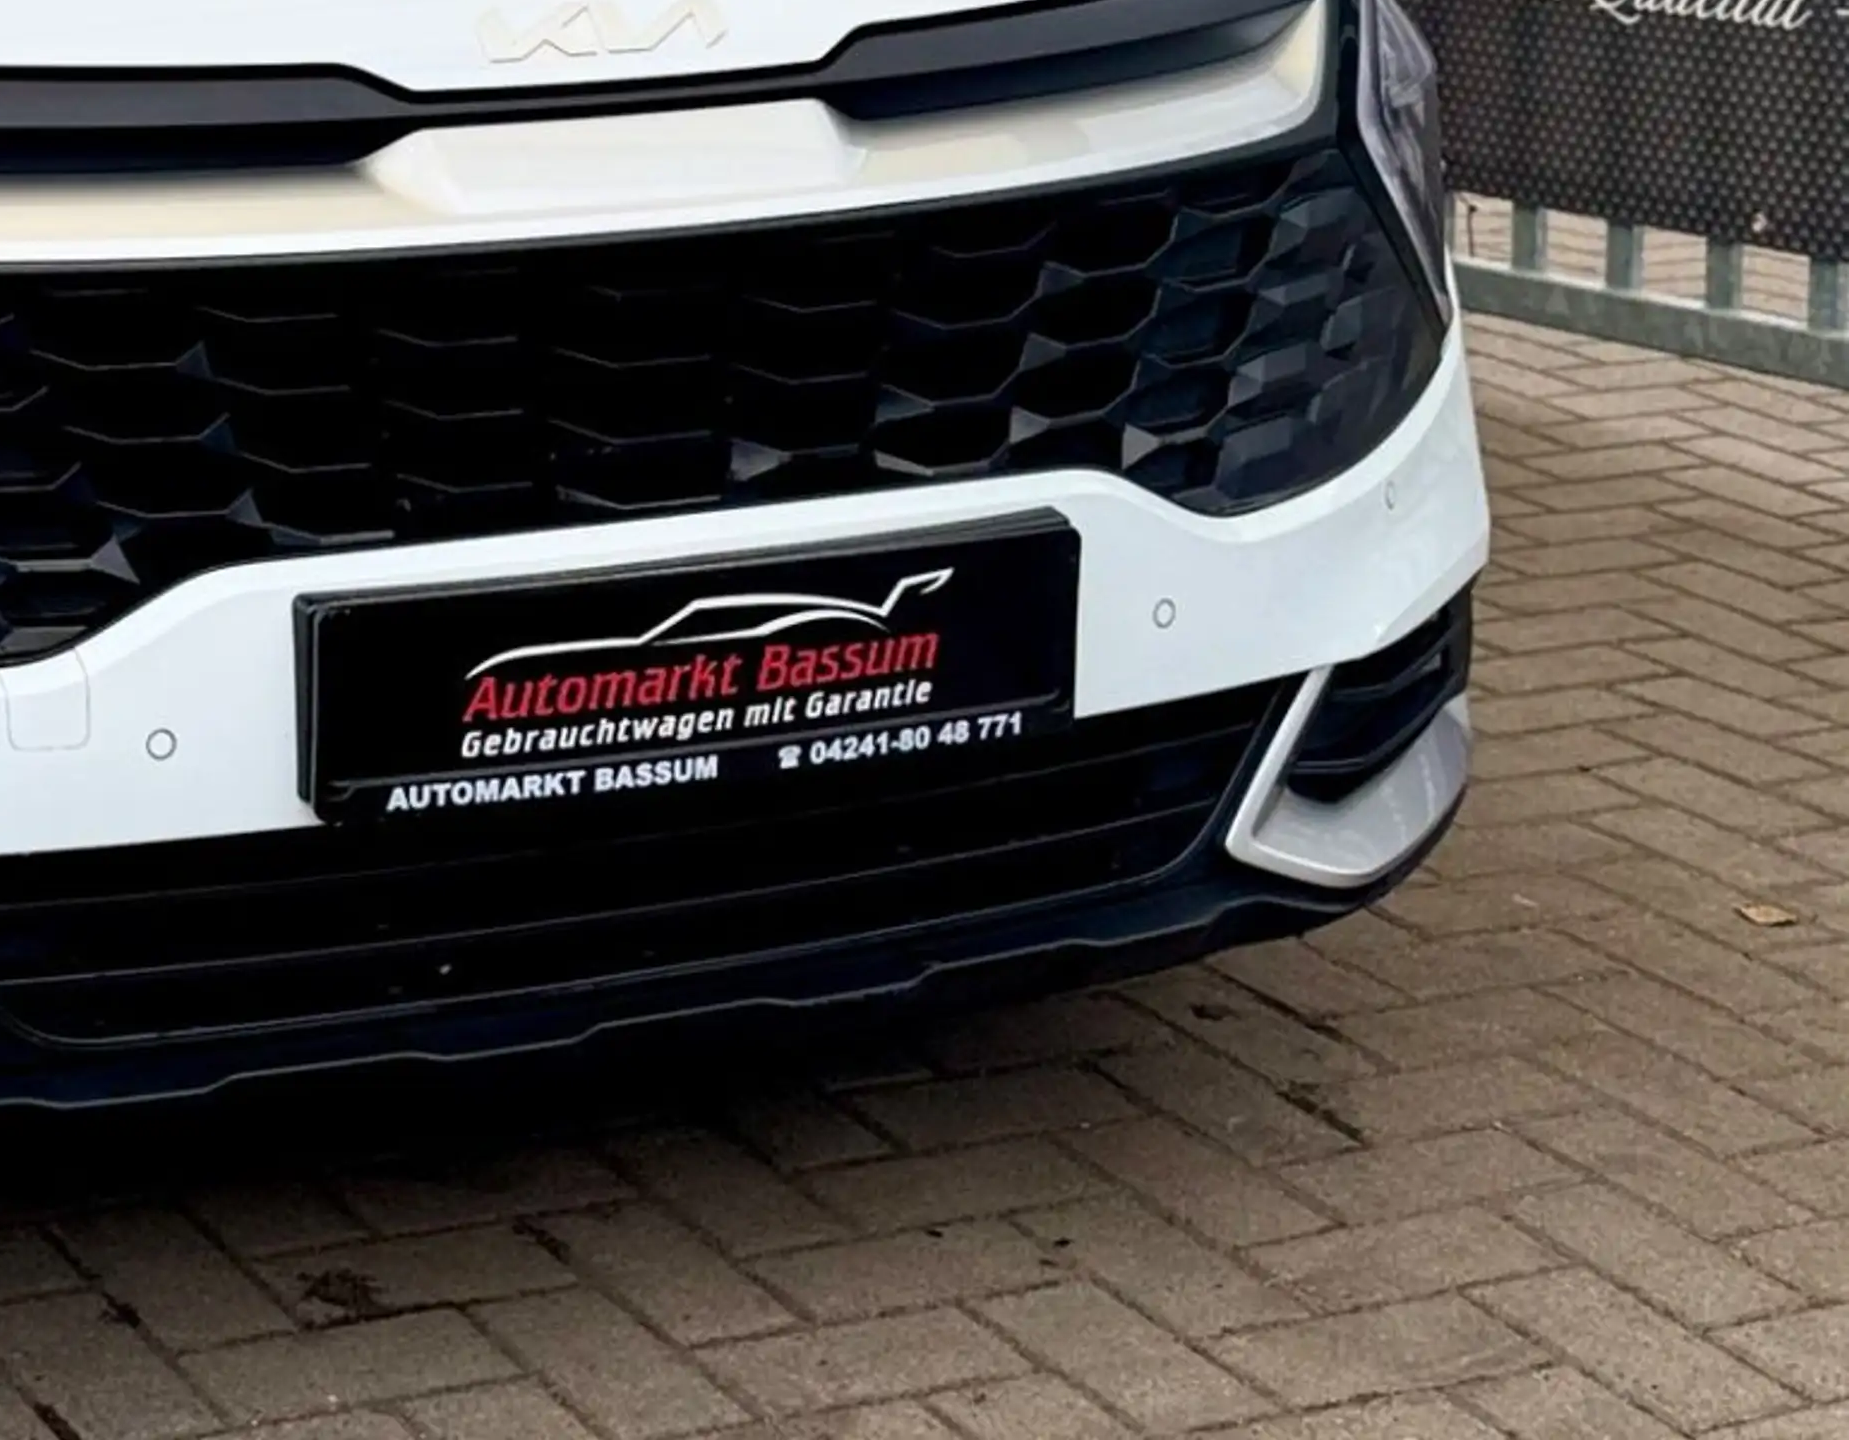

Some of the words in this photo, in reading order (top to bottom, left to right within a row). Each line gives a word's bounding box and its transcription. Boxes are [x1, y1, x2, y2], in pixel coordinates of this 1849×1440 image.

[462, 654, 743, 723] Automarkt
[756, 633, 940, 692] Bassum
[461, 707, 735, 759] Gebrauchtwagen
[744, 696, 796, 727] mit
[805, 677, 933, 719] Garantie
[809, 725, 931, 765] 04241-80
[937, 718, 971, 745] 48
[977, 710, 1022, 741] 771
[386, 770, 586, 812] AUTOMARKT
[593, 754, 719, 792] BASSUM
